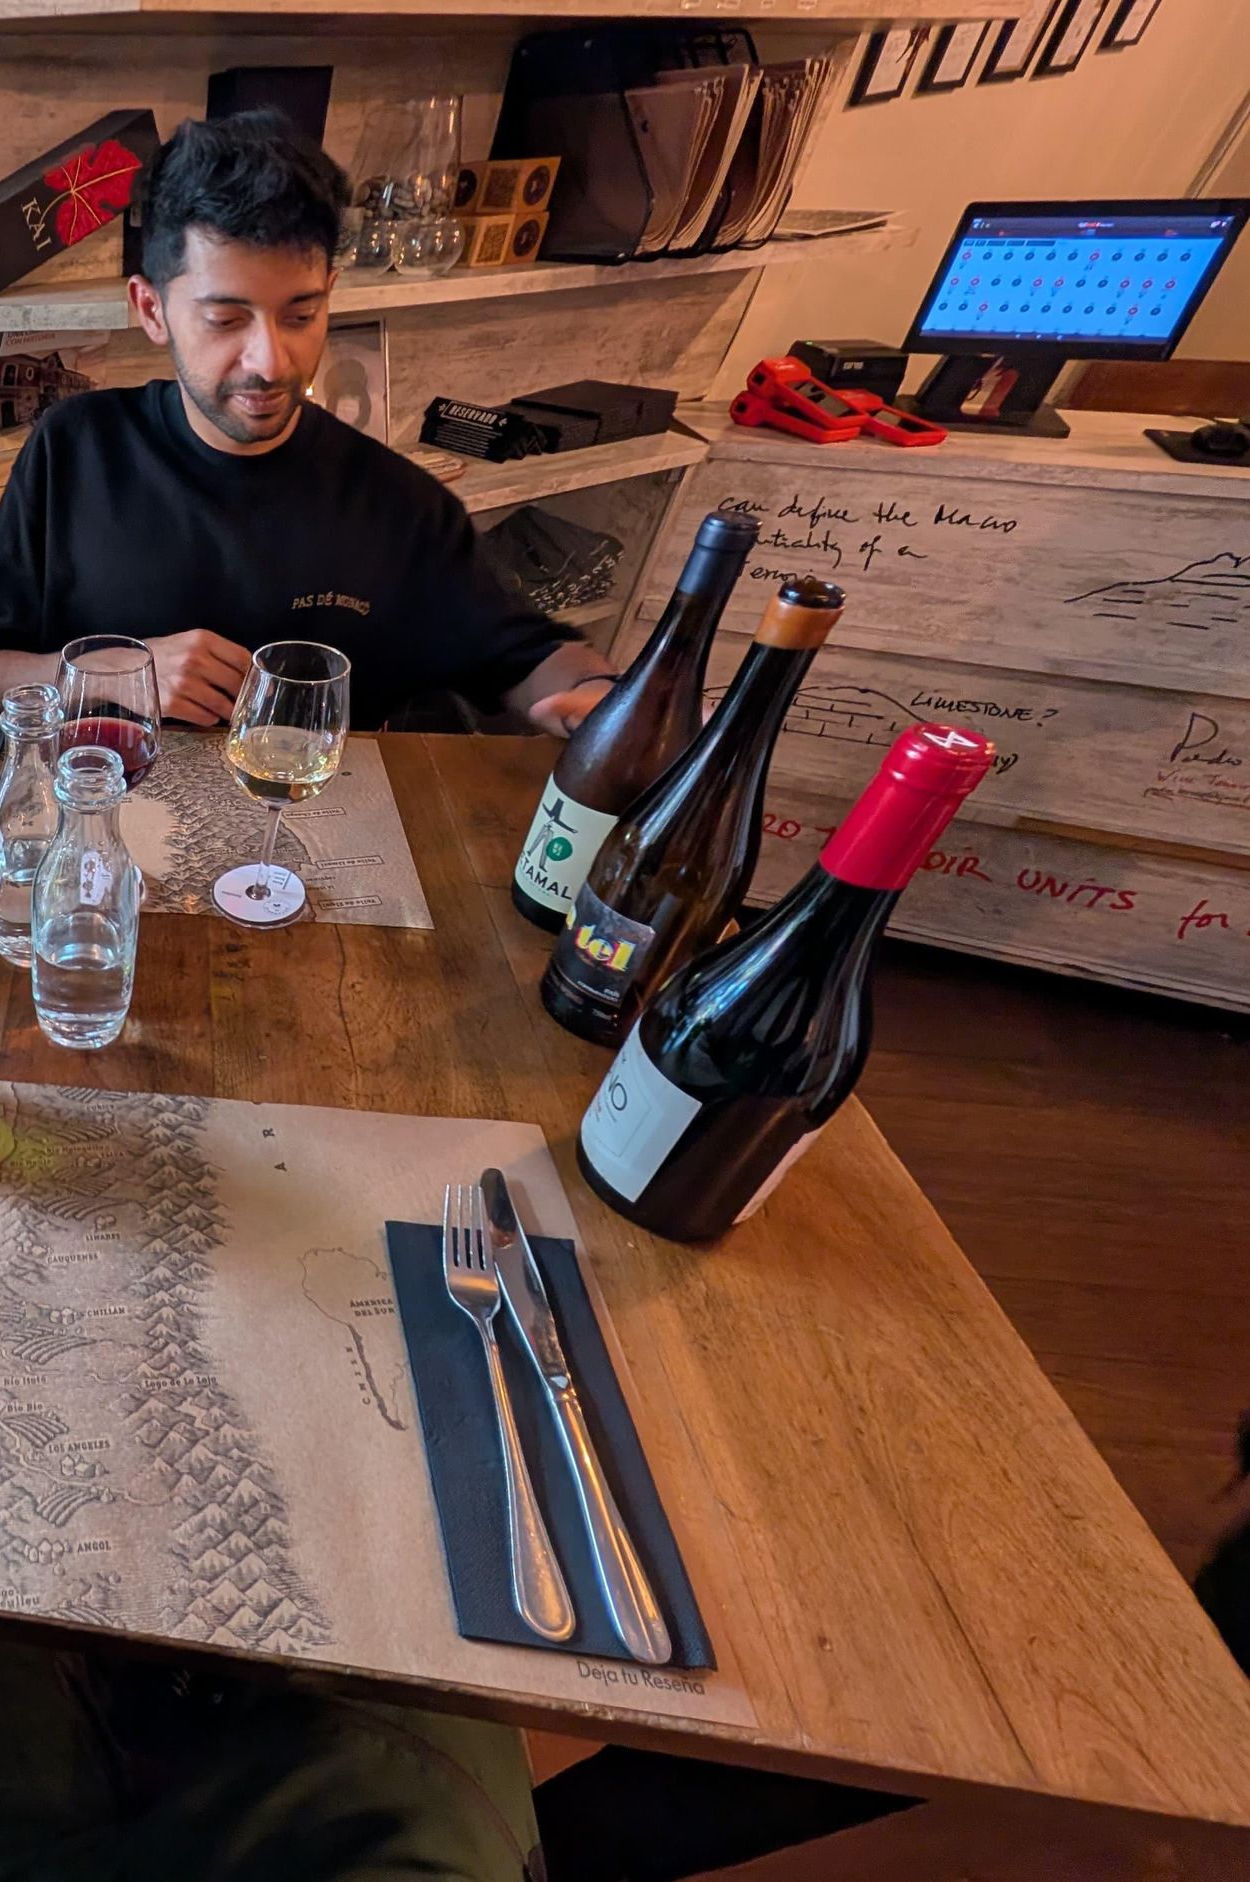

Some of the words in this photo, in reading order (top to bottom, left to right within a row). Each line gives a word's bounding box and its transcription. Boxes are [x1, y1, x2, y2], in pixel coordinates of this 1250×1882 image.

[21, 197, 52, 251] KAI
[448, 404, 499, 425] RESERVADO
[872, 502, 918, 527] the
[859, 535, 882, 571] of
[1177, 900, 1229, 940] for
[76, 1540, 112, 1552] ANGOL
[576, 1660, 620, 1687] Deja
[622, 1667, 639, 1686] tu
[640, 1668, 706, 1696] Reseña
